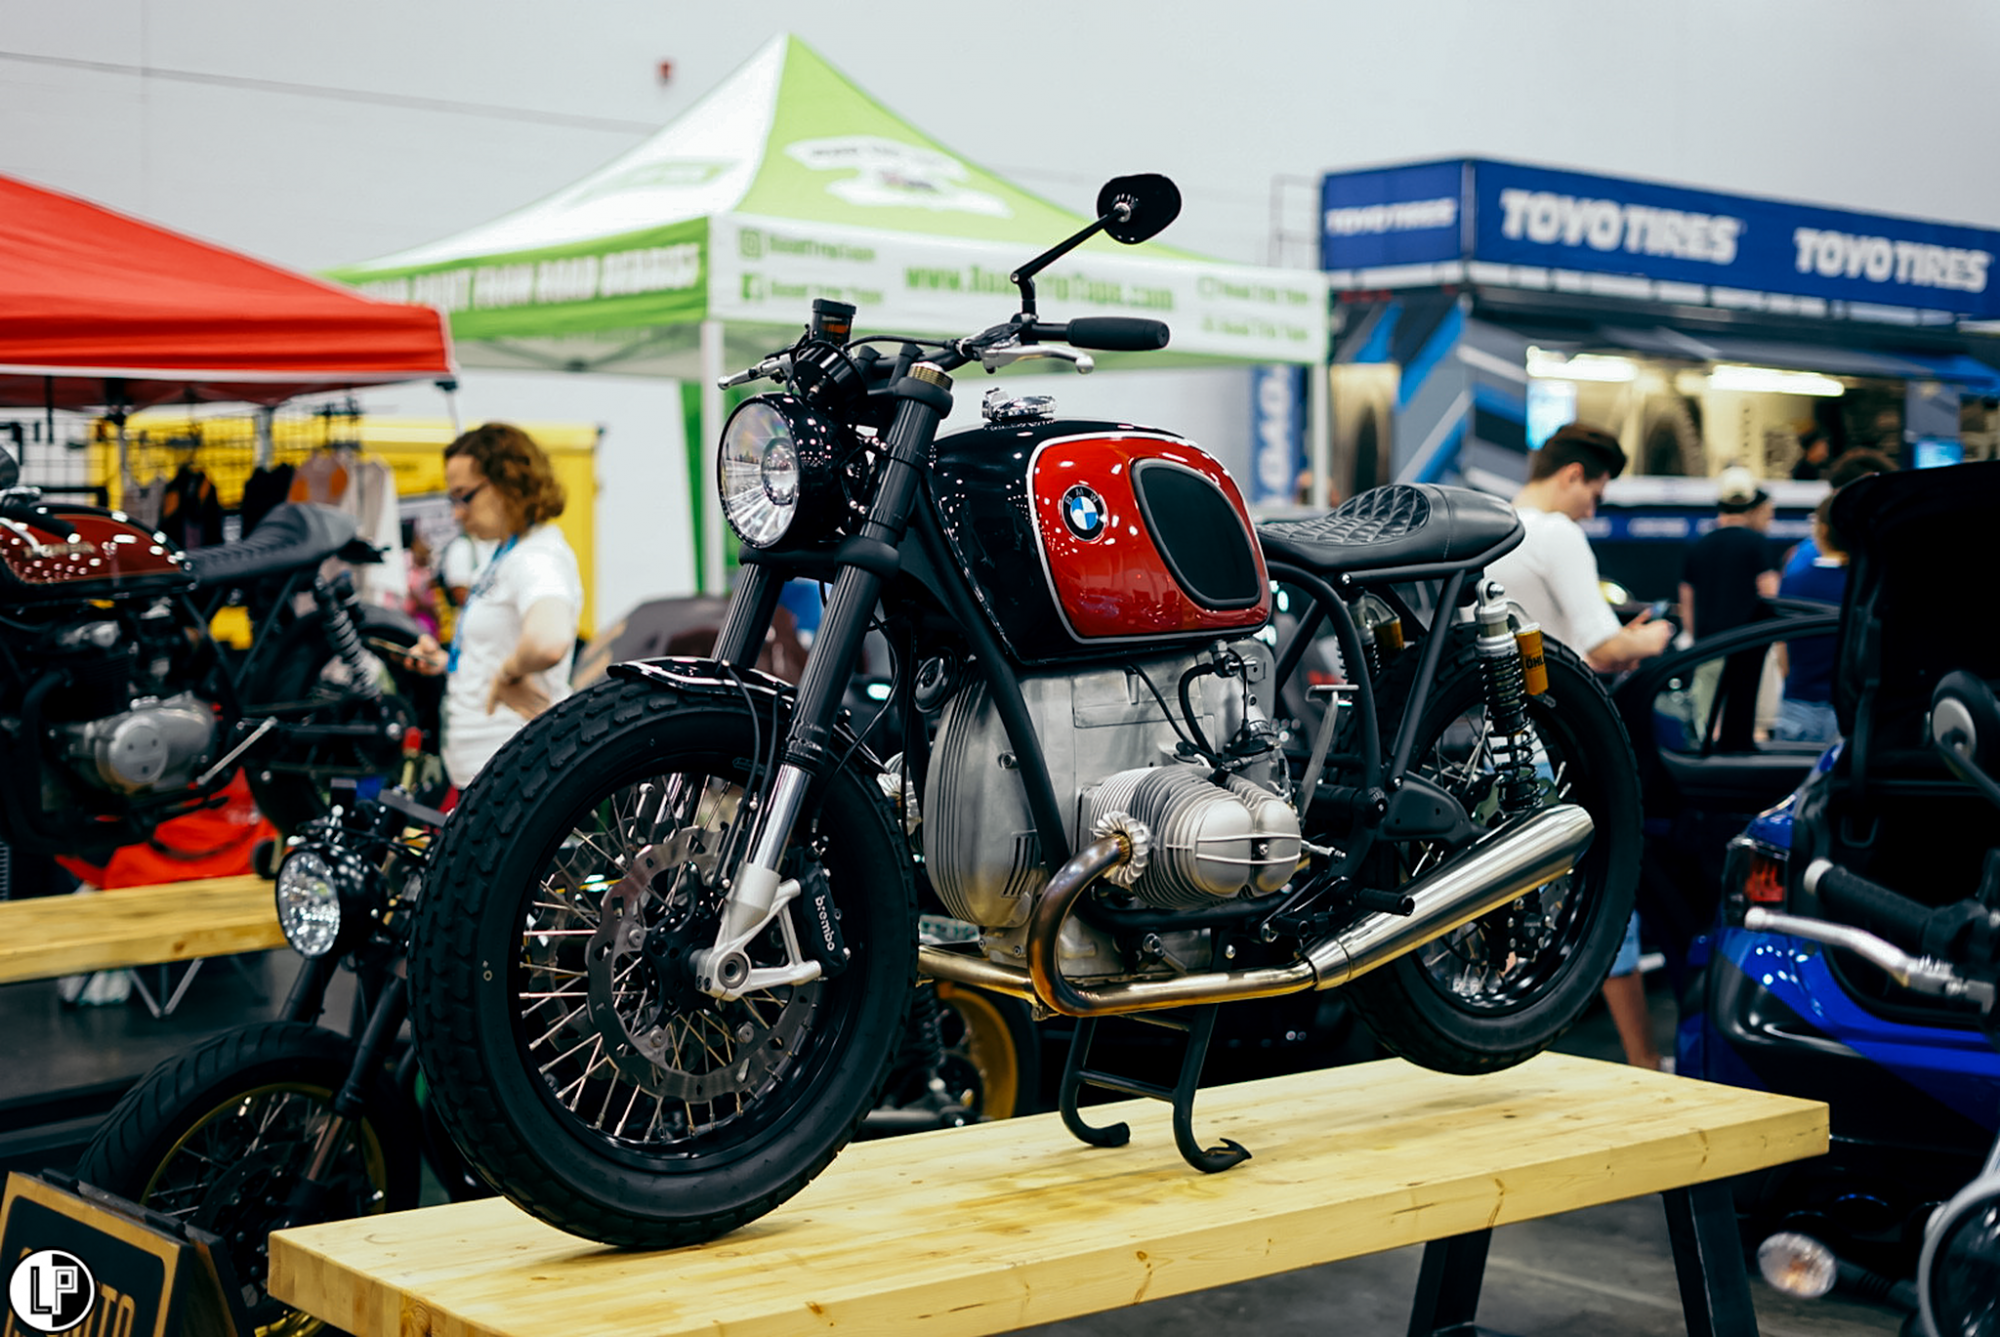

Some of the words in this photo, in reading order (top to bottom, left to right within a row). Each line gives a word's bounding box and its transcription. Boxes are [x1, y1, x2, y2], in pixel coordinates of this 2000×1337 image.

[1501, 188, 1623, 251] TOYO
[1623, 204, 1742, 265] TIRES
[1794, 227, 1894, 283] TOYO
[1894, 240, 1989, 293] TIRES
[1064, 488, 1099, 505] BMW
[815, 894, 835, 952] brembo
